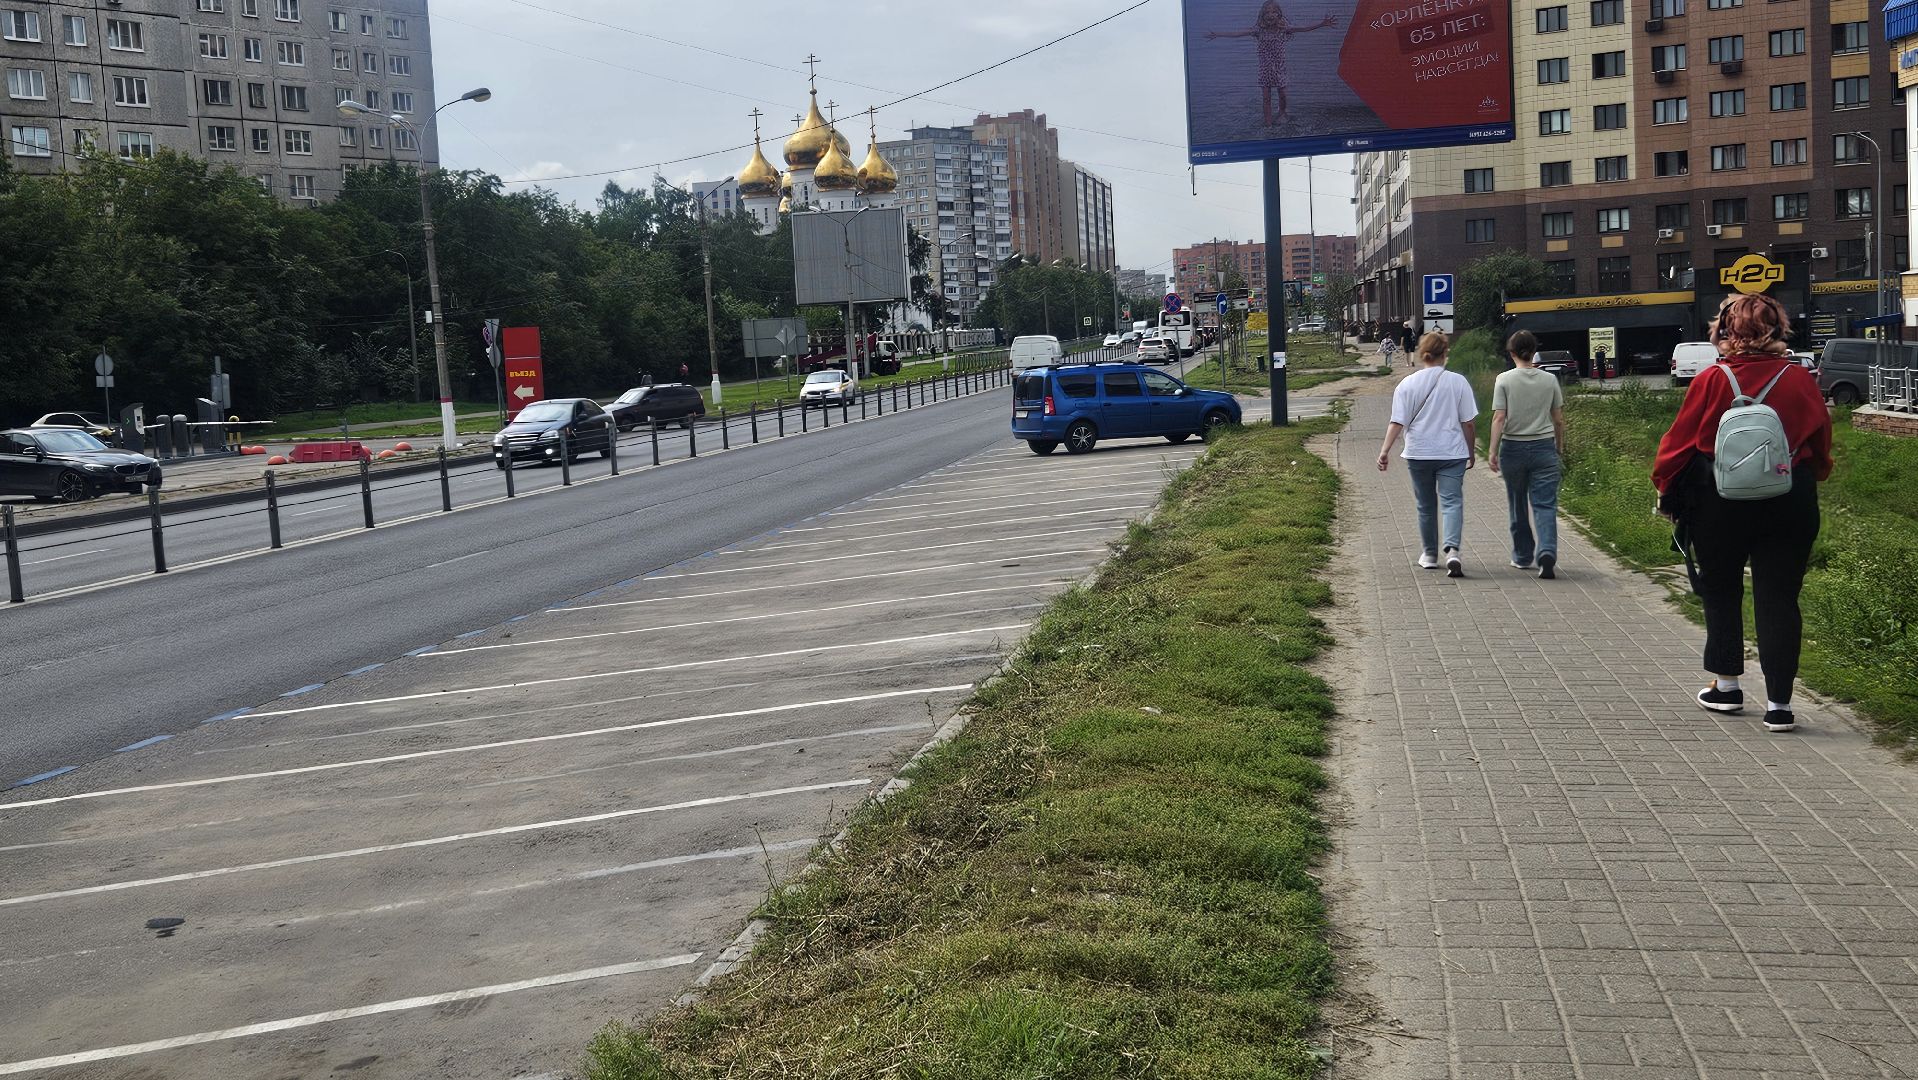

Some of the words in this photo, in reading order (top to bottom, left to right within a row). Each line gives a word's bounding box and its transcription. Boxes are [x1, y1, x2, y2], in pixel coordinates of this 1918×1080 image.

[1409, 25, 1436, 44] 65
[1410, 40, 1479, 67] ЭМОЦИИ
[1431, 278, 1448, 302] P
[1557, 297, 1640, 309] АВТОМОЙКА
